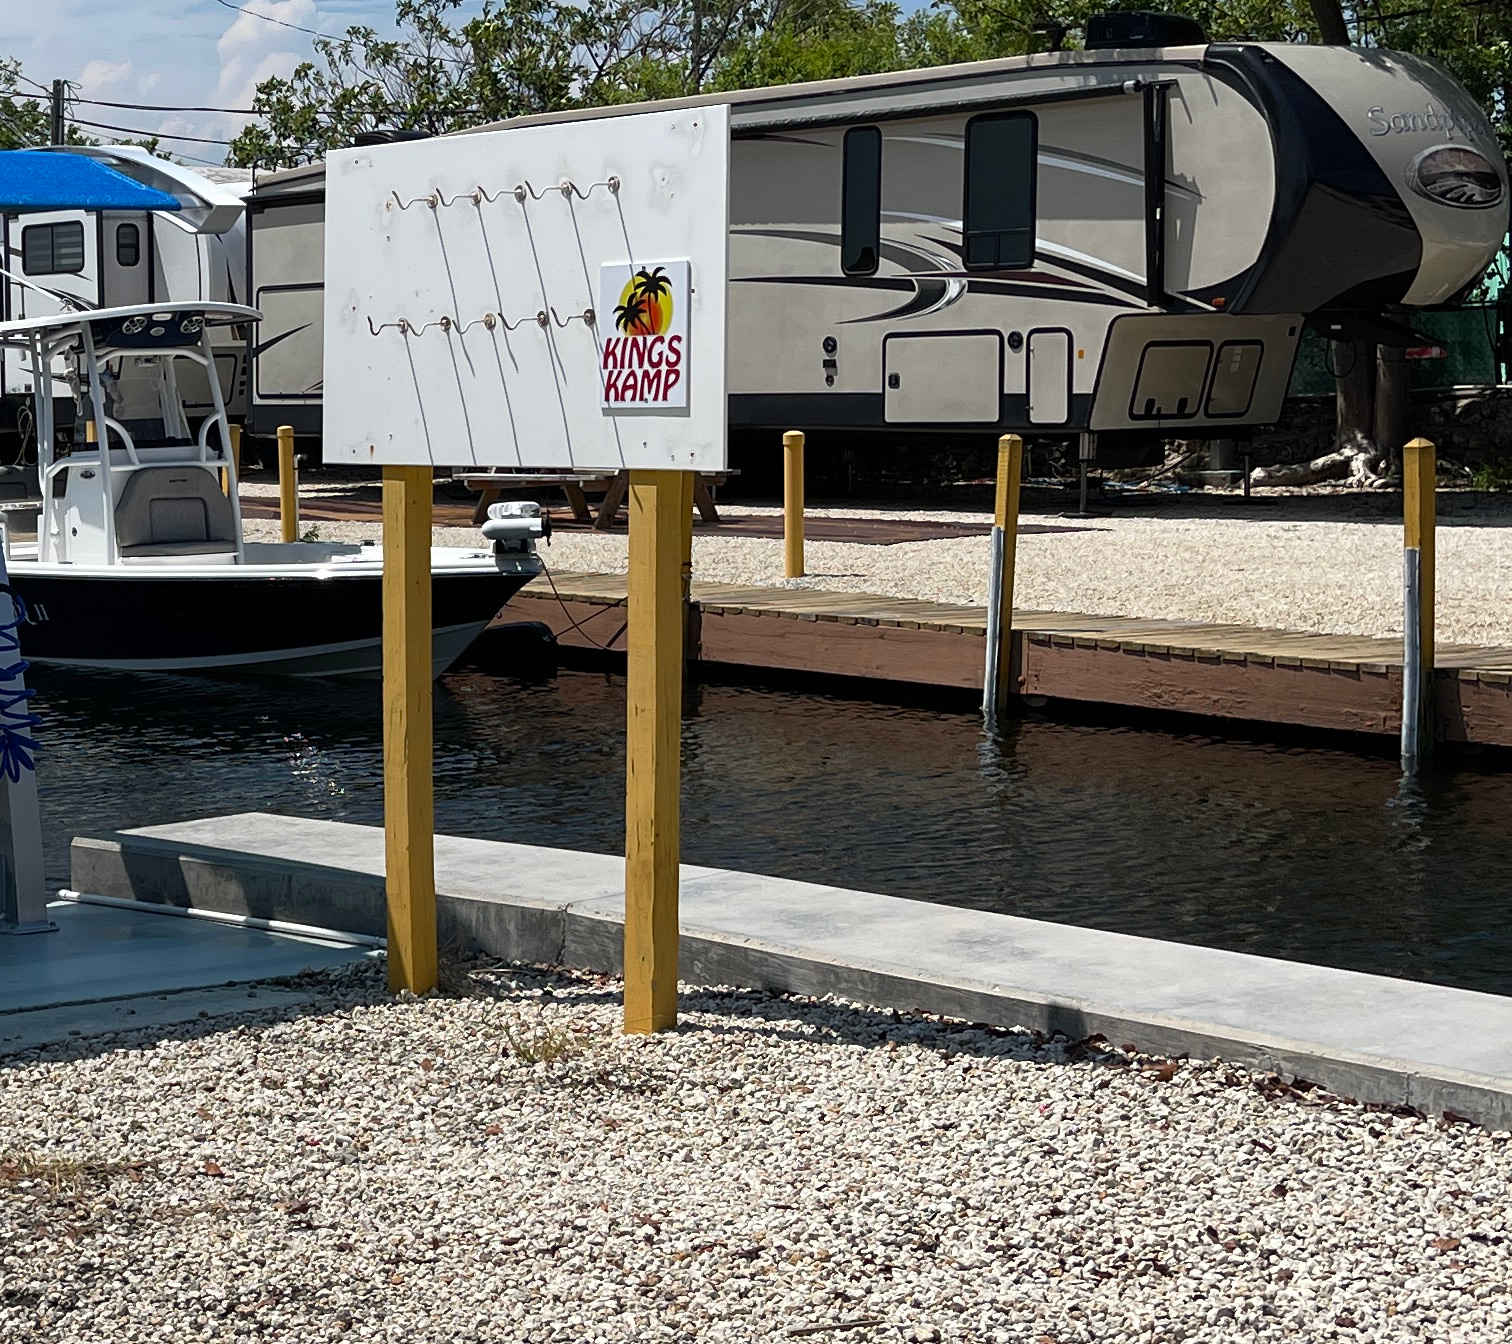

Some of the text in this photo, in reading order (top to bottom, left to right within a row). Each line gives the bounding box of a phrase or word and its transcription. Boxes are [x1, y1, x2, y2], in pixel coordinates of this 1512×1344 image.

[1367, 103, 1489, 142] Sandp
[602, 334, 683, 370] KINGS
[603, 368, 681, 402] KAMP
